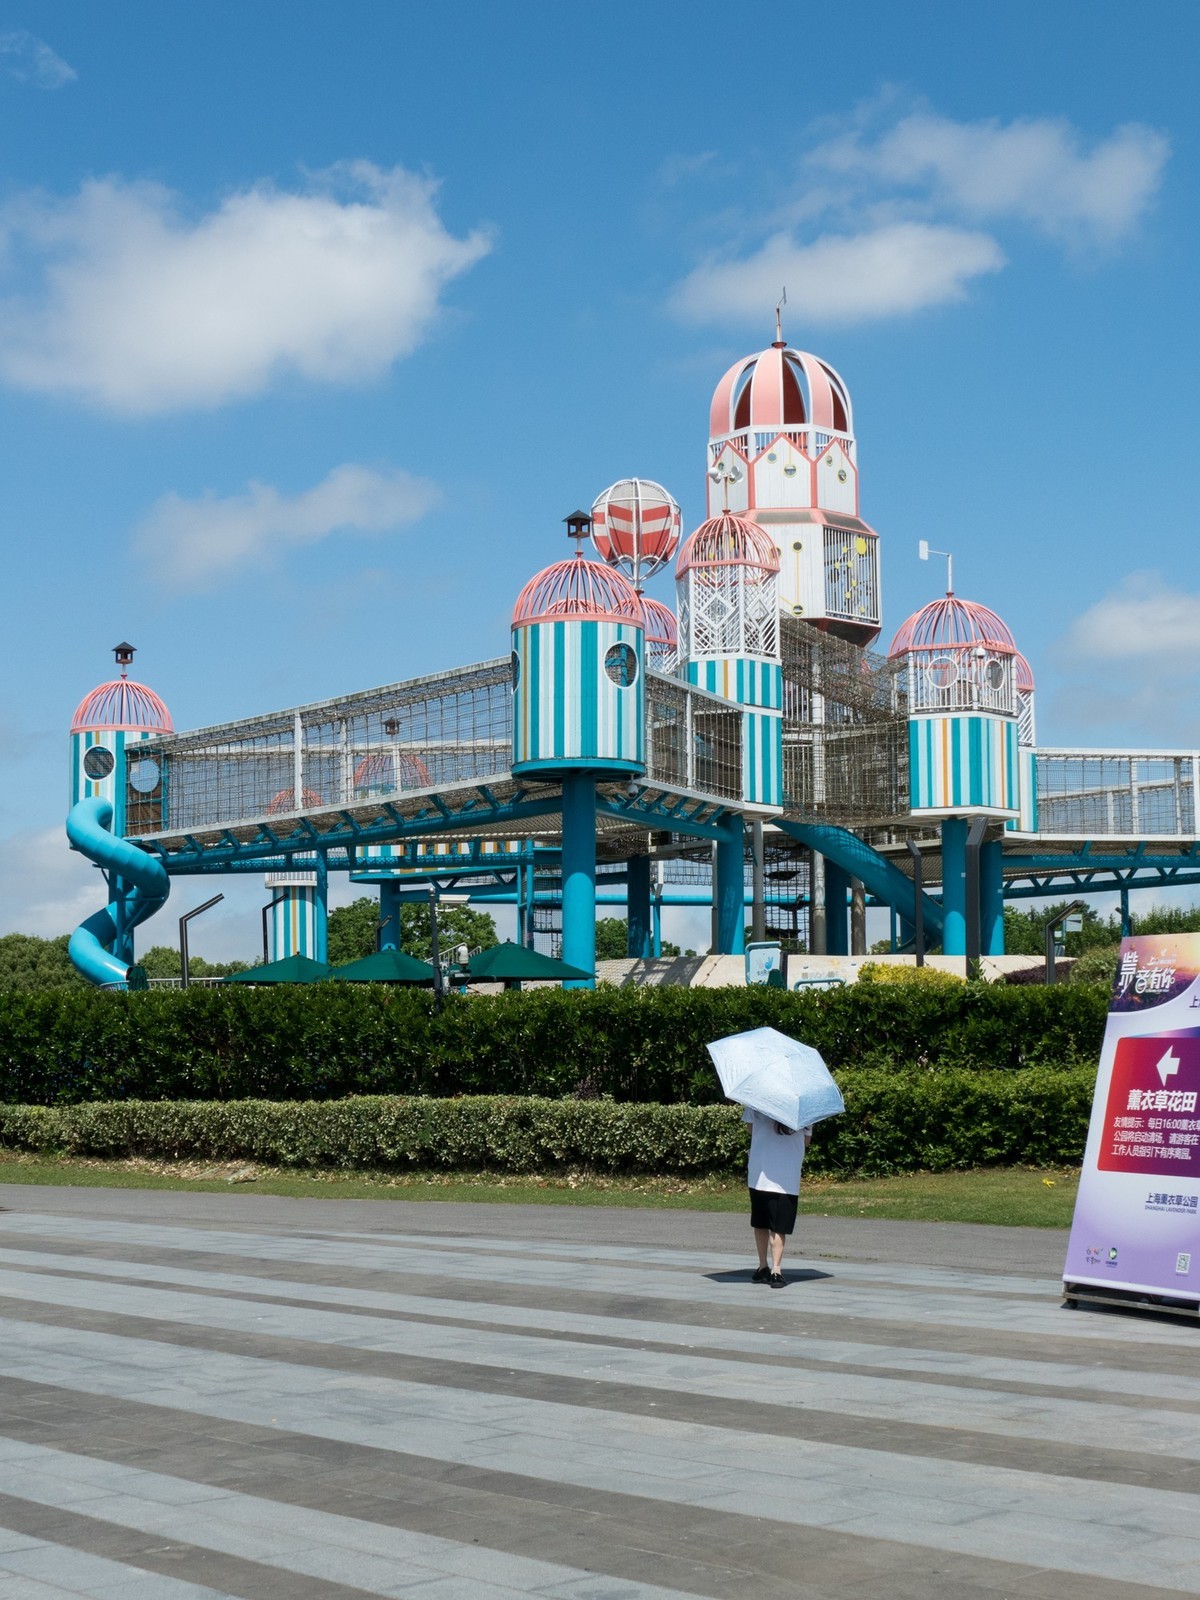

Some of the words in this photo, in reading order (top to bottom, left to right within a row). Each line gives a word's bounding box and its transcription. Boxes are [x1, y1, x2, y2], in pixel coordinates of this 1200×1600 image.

[1126, 1089, 1198, 1113] 薰衣草花田
[1145, 1192, 1199, 1208] 上海薰衣草公园
